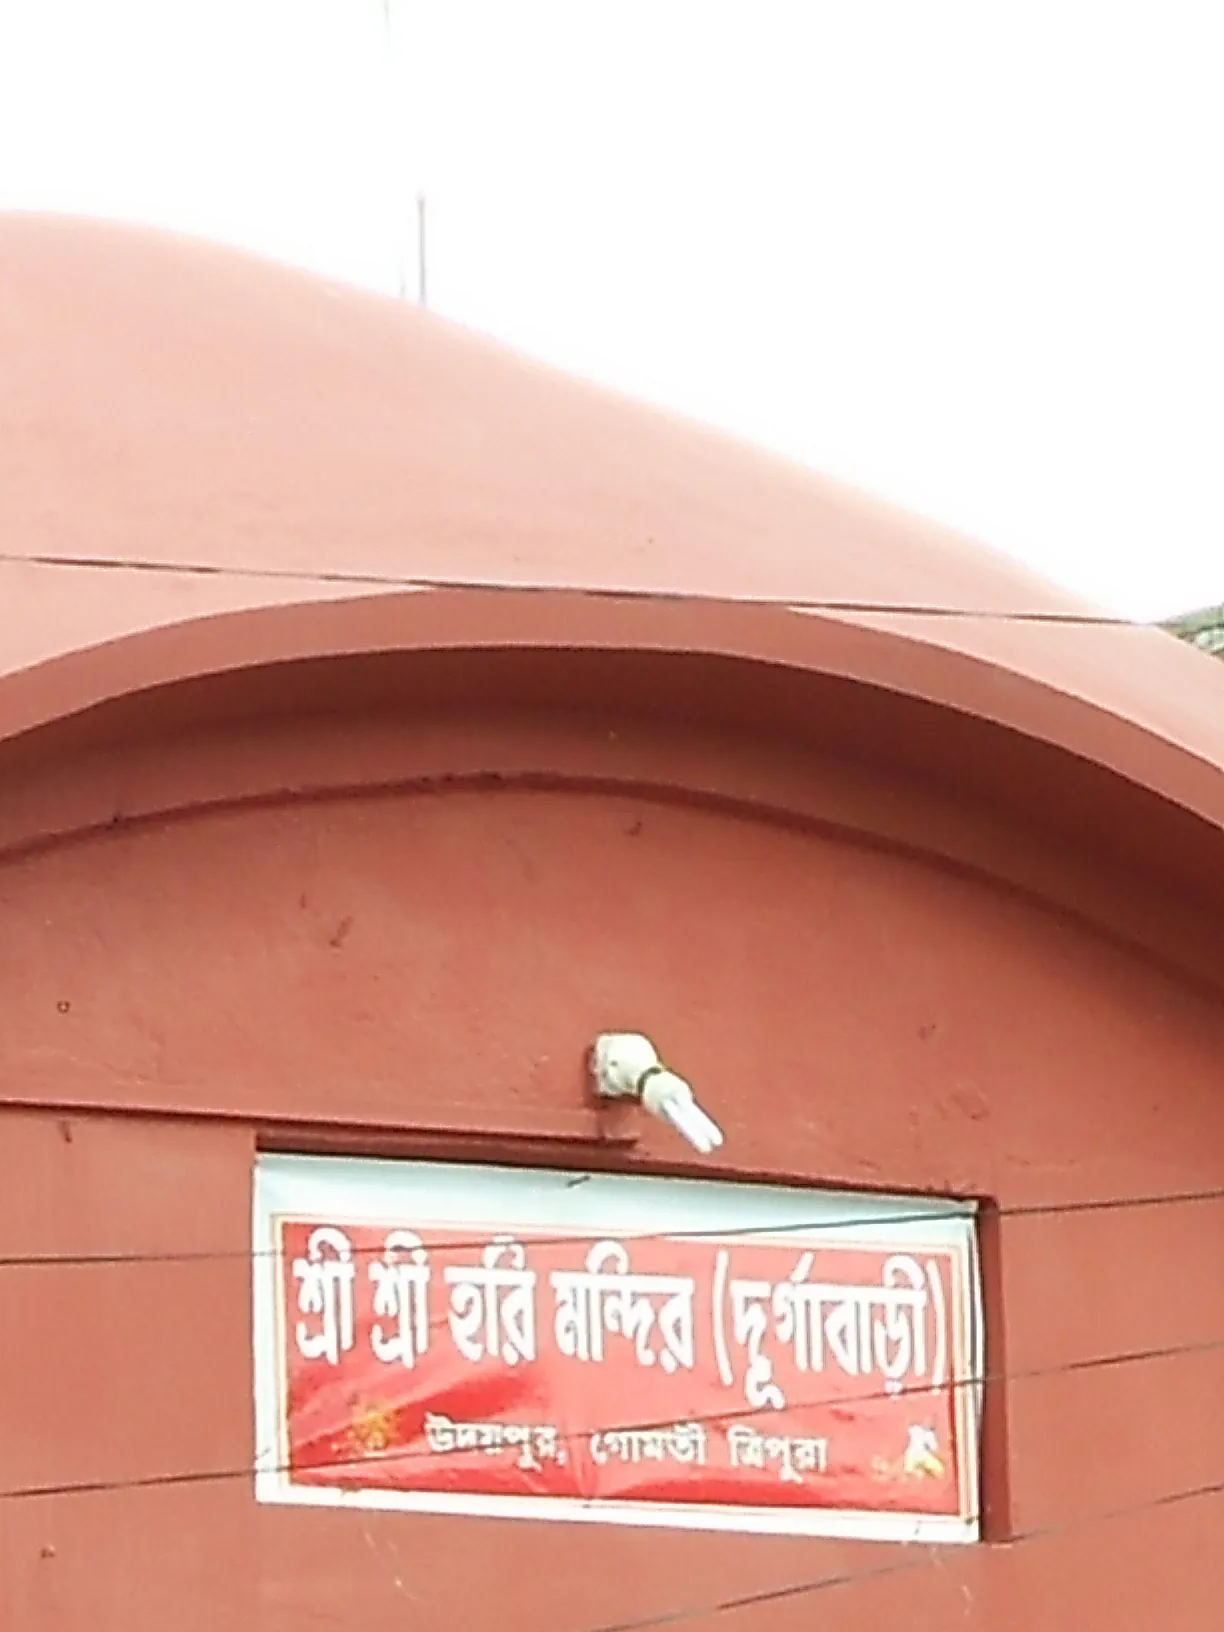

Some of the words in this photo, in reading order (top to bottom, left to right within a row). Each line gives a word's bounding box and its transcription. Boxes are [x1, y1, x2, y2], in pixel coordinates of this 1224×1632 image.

[293, 1226, 355, 1365] শ্রী
[368, 1229, 430, 1368] শ্রী
[444, 1235, 537, 1366] হরি
[550, 1240, 694, 1373] মন্দির
